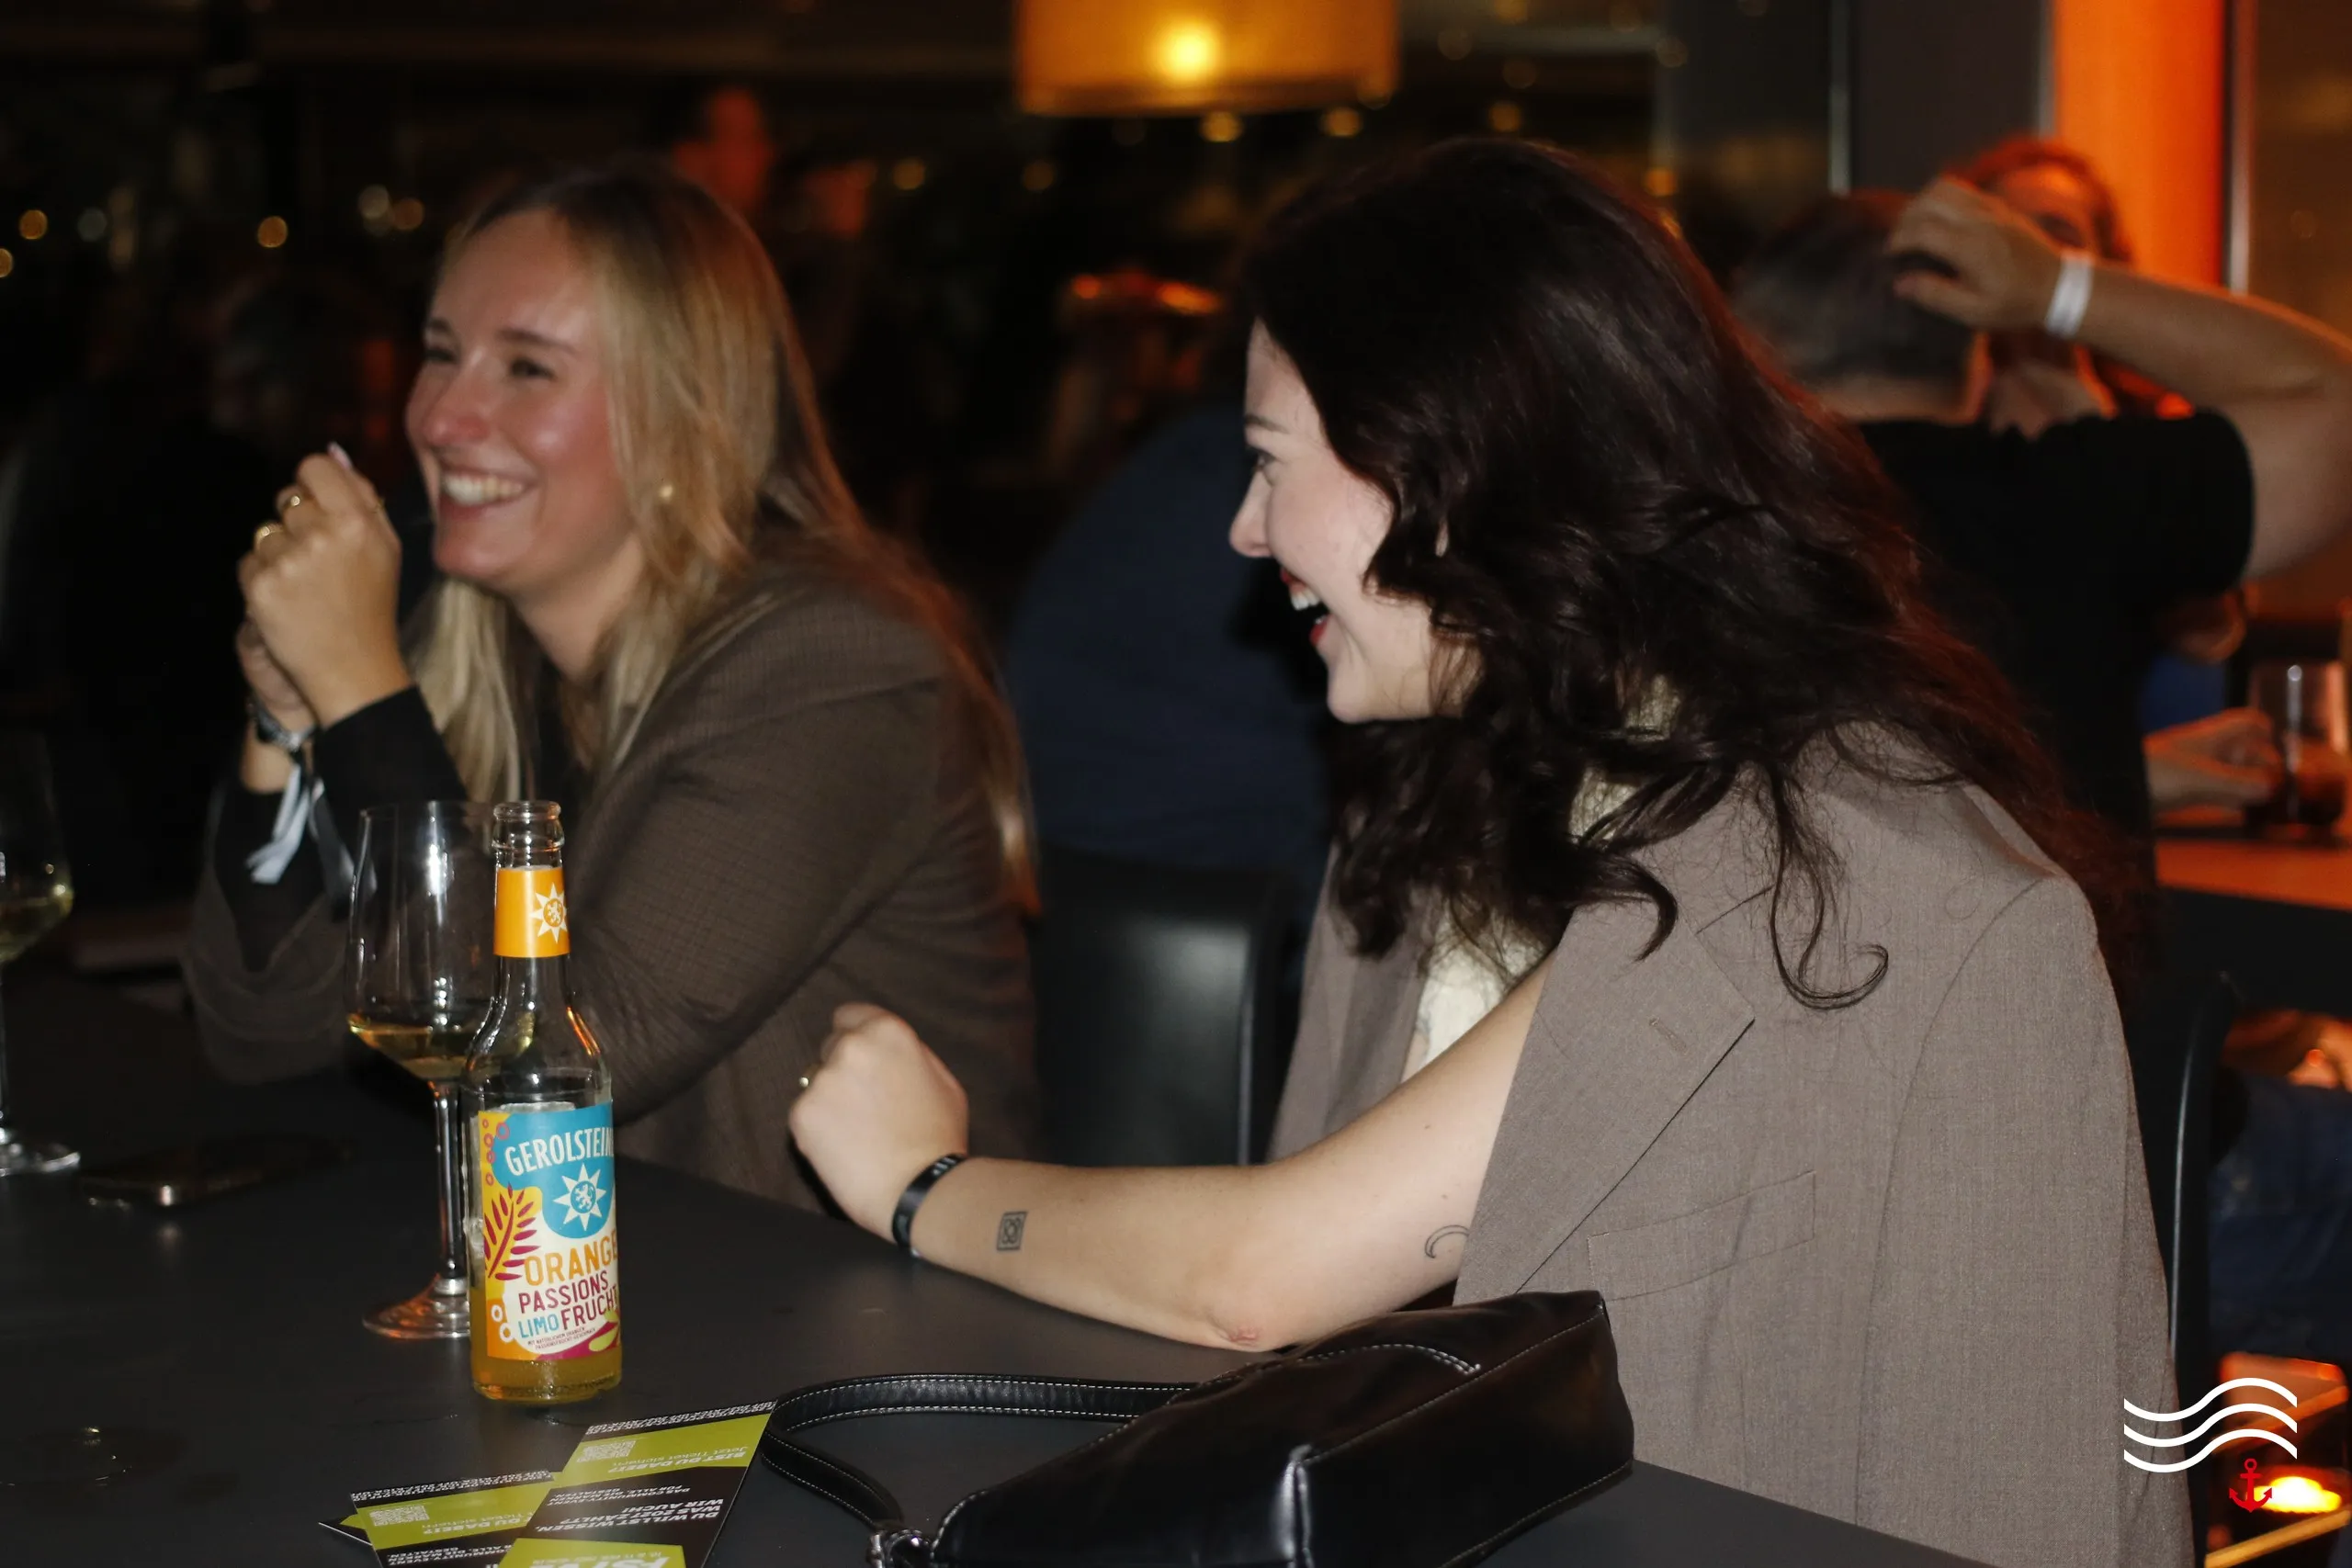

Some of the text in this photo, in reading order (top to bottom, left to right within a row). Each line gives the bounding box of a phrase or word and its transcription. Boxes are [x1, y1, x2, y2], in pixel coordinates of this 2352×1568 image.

[525, 1230, 617, 1286] ORANGE
[518, 1269, 608, 1314] PASSIONS
[518, 1314, 559, 1338] LIMO
[674, 1457, 701, 1465] DU
[620, 1498, 723, 1514] WIR AUCH!
[676, 1505, 720, 1514] WAS
[616, 1514, 688, 1525] WILLST
